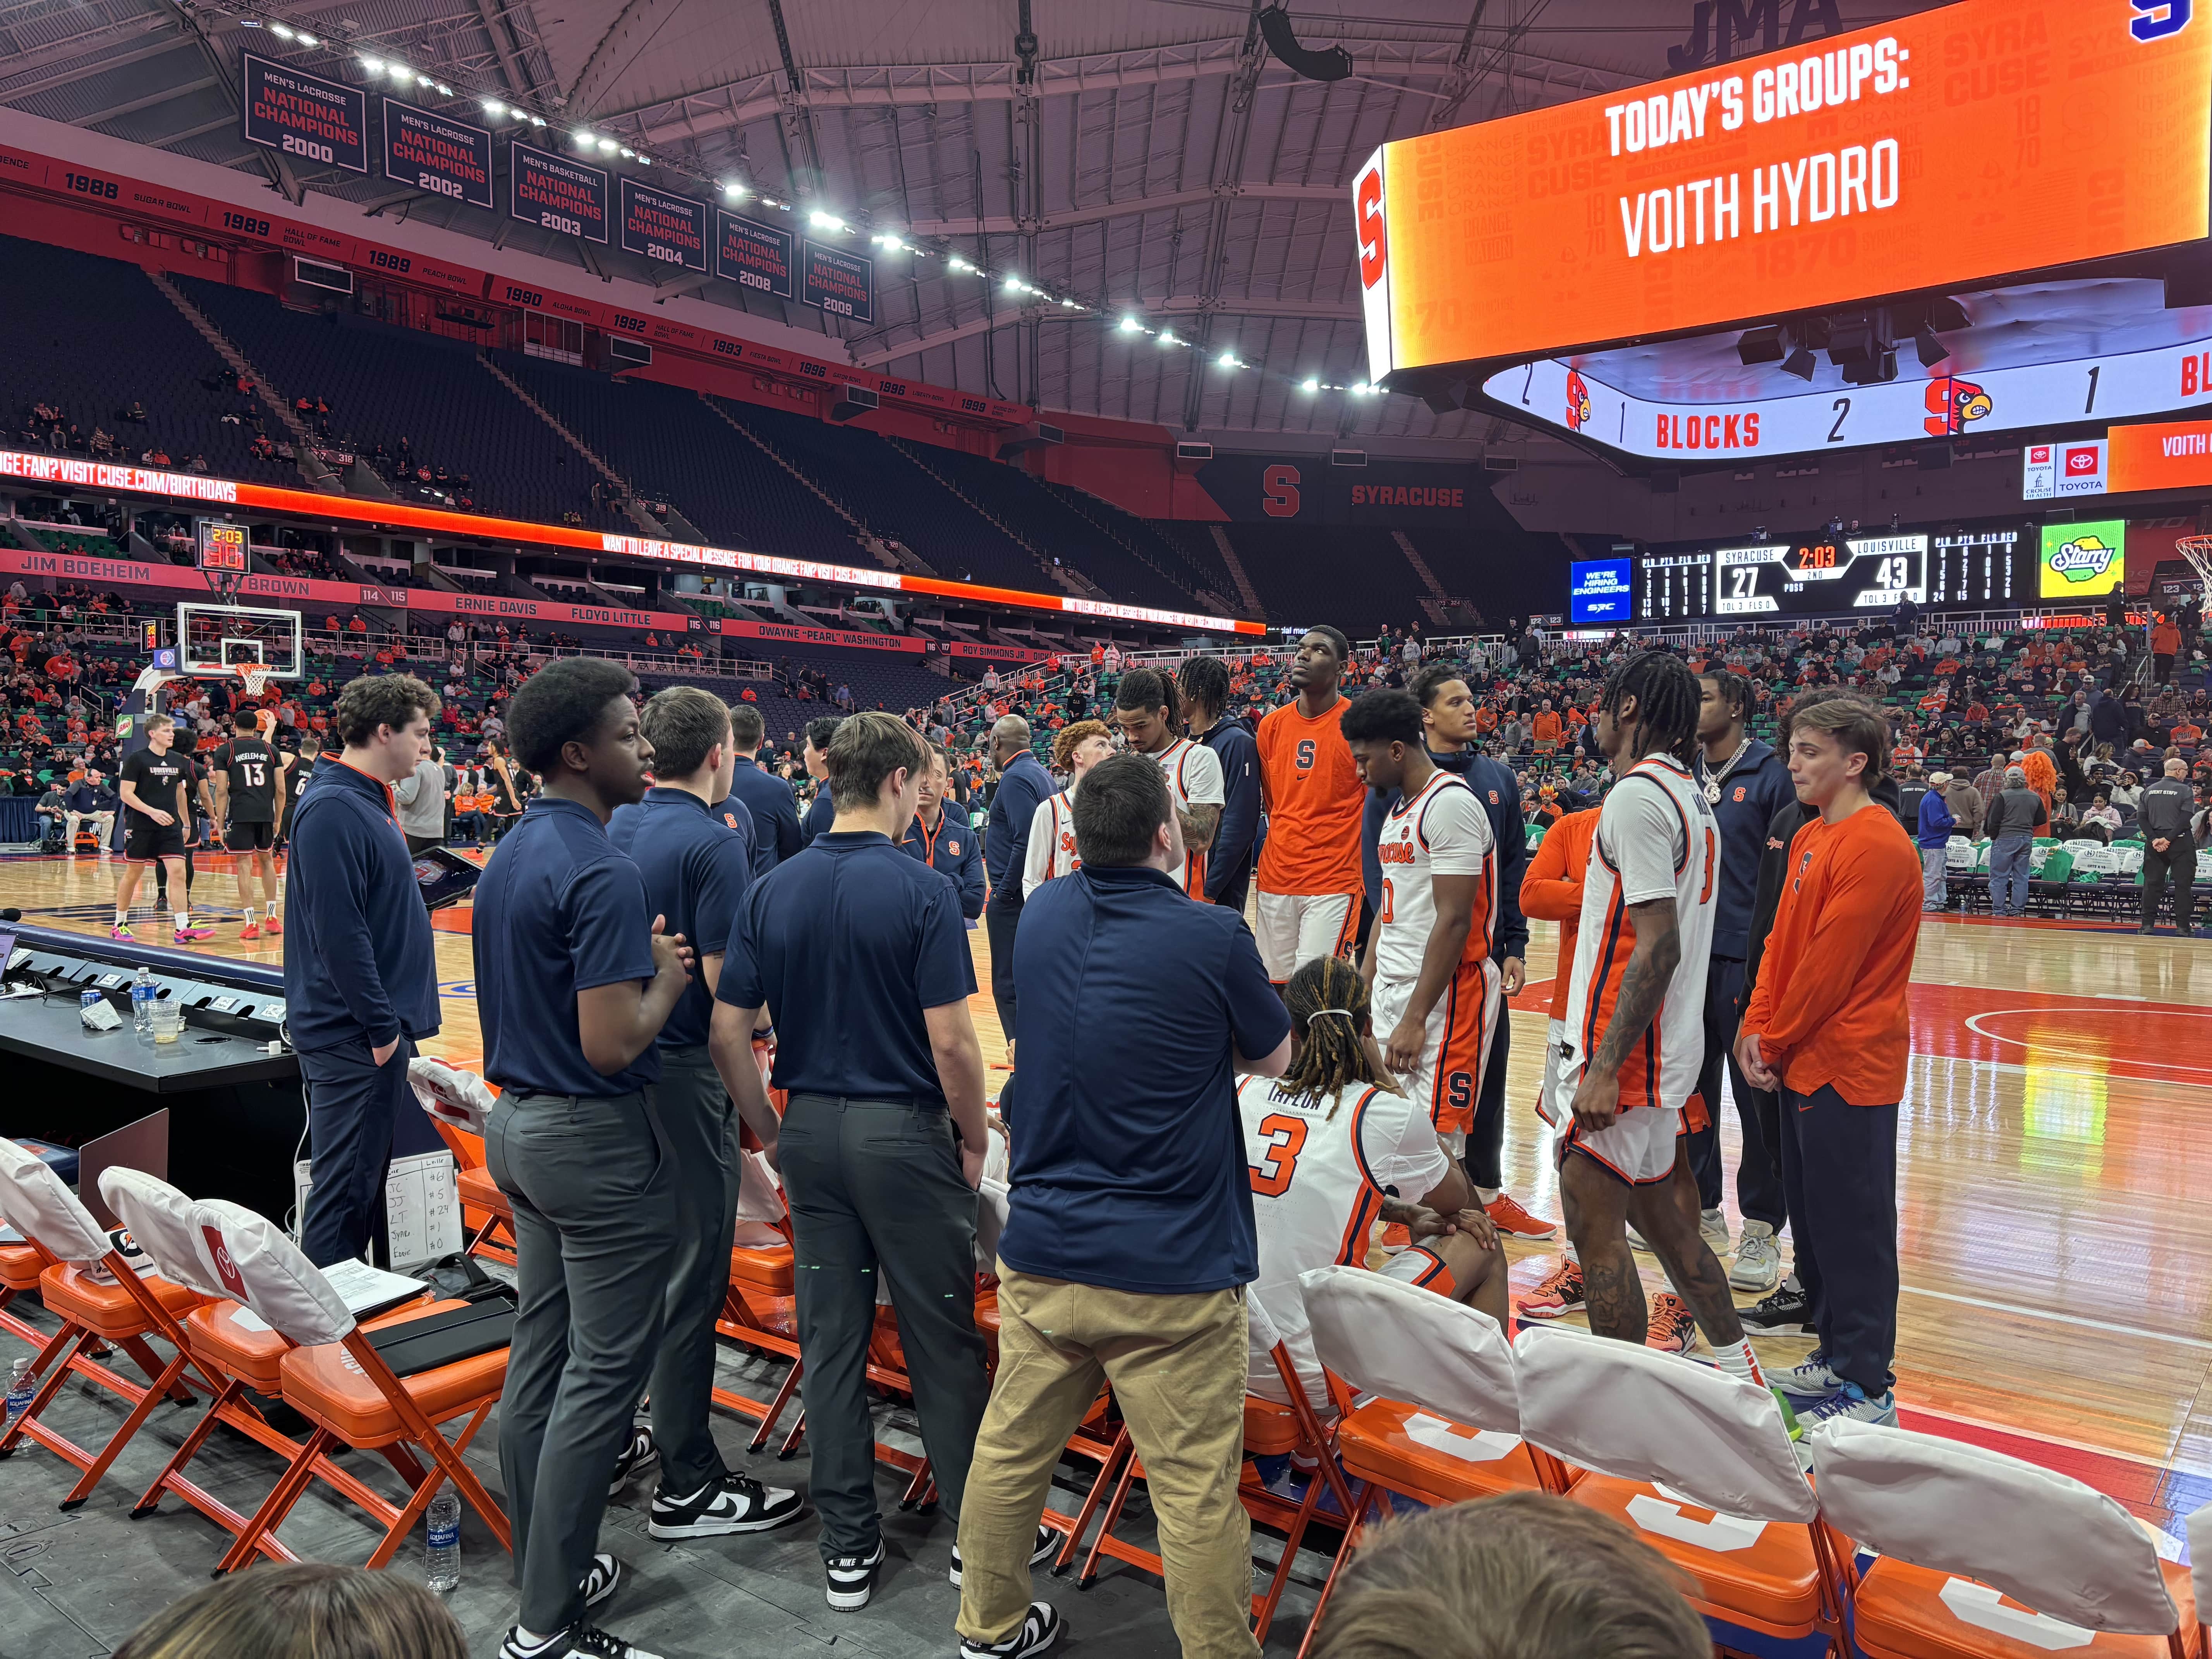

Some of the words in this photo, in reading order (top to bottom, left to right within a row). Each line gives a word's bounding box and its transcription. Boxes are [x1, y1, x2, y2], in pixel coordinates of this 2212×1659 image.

[264, 71, 294, 89] MEN'S
[297, 81, 347, 106] LACROSSE
[1606, 77, 1742, 156] TODAY'S
[1753, 37, 1910, 123] GROUPS:
[263, 87, 349, 128] NATIONAL
[254, 101, 358, 146] CHAMPIONS
[401, 113, 429, 130] MEN'S
[431, 122, 474, 146] LACROSSE
[282, 134, 333, 165] 2000
[401, 128, 477, 166] NATIONAL
[393, 141, 485, 184] CHAMPIONS
[523, 155, 548, 170] MEN'S
[550, 163, 597, 186] BASKETBALL
[66, 173, 118, 199] 1988
[134, 194, 164, 207] SUGAR
[167, 201, 191, 213] BOWL
[419, 171, 463, 200] 2002
[527, 170, 594, 204] NATIONAL
[520, 183, 601, 220] CHAMPIONS
[635, 192, 657, 206] MEN'S
[659, 200, 692, 216] LACROSSE
[1620, 173, 1738, 257] VOITH
[1753, 139, 1899, 234] HYDRO
[223, 212, 270, 237] 1989
[542, 211, 580, 236] 2003
[635, 205, 694, 234] NATIONAL
[283, 235, 306, 247] BOWL
[285, 227, 304, 238] HALL
[319, 236, 340, 247] FAME
[628, 217, 700, 249] CHAMPIONS
[730, 223, 748, 235] MEN'S
[750, 229, 780, 246] LACROSSE
[647, 243, 683, 265] 2004
[728, 234, 781, 262] NATIONAL
[368, 249, 411, 273] 1989
[422, 267, 445, 280] PEACH
[447, 273, 467, 285] BOWL
[723, 246, 786, 277] CHAMPIONS
[815, 251, 832, 263] MEN'S
[833, 257, 861, 272] LACROSSE
[740, 271, 771, 291] 2008
[814, 263, 861, 288] NATIONAL
[809, 274, 866, 302] CHAMPIONS
[506, 286, 543, 307] 1990
[552, 301, 572, 312] ALOHA
[574, 307, 591, 316] BOWL
[824, 297, 852, 316] 2009
[614, 314, 646, 333] 1992
[656, 324, 670, 332] HALL
[679, 329, 694, 338] FAME
[713, 339, 743, 356] 1993
[750, 351, 766, 360] FIESTA
[767, 356, 781, 364] BOWL
[799, 361, 826, 378] 1996
[833, 372, 848, 381] GATOR
[848, 375, 861, 384] BOWL
[879, 380, 906, 396] 1996
[912, 390, 931, 400] LIBERTY
[2085, 367, 2100, 413] 1
[961, 398, 986, 413] 1999
[1657, 412, 1759, 448] BLOCKS
[1827, 398, 1850, 442] 2
[2162, 434, 2205, 456] VOITH
[339, 454, 353, 463] 318
[23, 455, 58, 479] FAN?
[60, 460, 95, 483] VISIT
[98, 465, 237, 502] CUSE.COM/BIRTHDAYS
[2059, 481, 2102, 491] TOYOTA
[1263, 465, 1300, 517] S
[1352, 485, 1463, 507] SYRACUSE
[213, 528, 242, 544] 2:03
[1858, 539, 1916, 553] LOUISVILLE
[210, 543, 239, 567] 30
[603, 535, 627, 552] WANT
[627, 538, 638, 553] TO
[639, 539, 663, 558] LEAVE
[663, 544, 670, 558] A
[670, 544, 702, 563] SPECIAL
[702, 548, 737, 567] MESSAGE
[738, 554, 752, 569] FOR
[754, 555, 771, 571] YOUR
[772, 559, 799, 575] ORANGE
[800, 562, 817, 578] FAN?
[817, 565, 834, 579] VISIT
[1726, 549, 1774, 563] SYRACUSE
[1799, 546, 1835, 569] 2:03
[2051, 543, 2113, 573] Starry
[21, 556, 56, 572] JIM
[63, 560, 150, 581] BOEHEIM
[1586, 571, 1616, 580] WE'RE
[1808, 571, 1822, 579] 2ND
[1876, 557, 1907, 589] 43
[249, 578, 309, 595] BROWN
[1573, 585, 1629, 595] ENGINEERS
[1584, 578, 1618, 587] HIRING
[1733, 567, 1759, 598] 27
[1784, 583, 1803, 592] POSS
[363, 590, 378, 601] 114
[391, 591, 405, 601] 115
[456, 597, 496, 613] ERNIE
[499, 601, 536, 615] DAVIS
[1643, 598, 1651, 608] 13
[1662, 597, 1669, 606] 10
[1723, 602, 1735, 611] TOL
[1750, 600, 1762, 610] FLS
[1766, 601, 1769, 609] 0
[1864, 594, 1878, 603] TOL
[1933, 592, 1944, 602] 24
[1957, 591, 1967, 601] 15
[572, 608, 610, 622] FLOYD
[613, 611, 651, 625] LITTLE
[1587, 603, 1616, 614] SRC
[1642, 608, 1651, 617] 44
[690, 620, 701, 629] 115
[710, 621, 720, 629] 116
[759, 625, 800, 639] DWAYNE
[843, 634, 901, 648] WASHINGTON
[963, 646, 977, 654] ROY
[980, 647, 1014, 658] SIMMONS
[1016, 650, 1026, 659] JR.
[1034, 652, 1049, 661] DICK
[235, 753, 268, 763] ANSELEM-IDE
[1296, 739, 1316, 769] S
[242, 763, 265, 787] 13
[295, 778, 307, 796] 6
[1489, 790, 1499, 804] S
[1733, 787, 1746, 802] S
[724, 813, 737, 828] S
[949, 840, 960, 855] S
[1449, 1072, 1471, 1108] S
[1249, 1113, 1309, 1197] 3
[429, 1533, 454, 1541] AQUAFINA
[839, 1558, 856, 1567] NIKE
